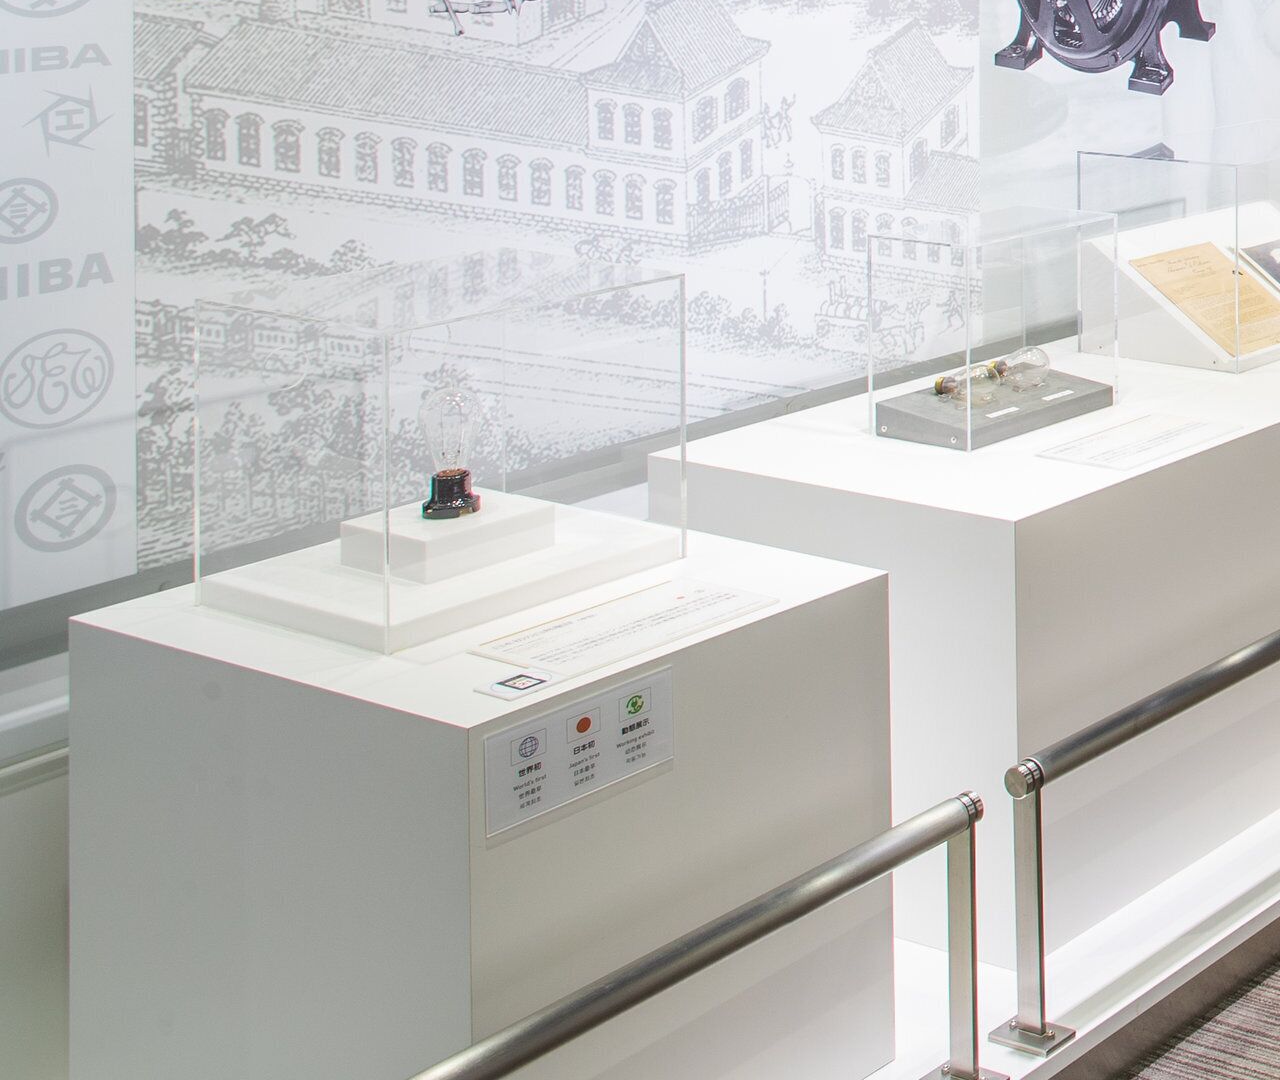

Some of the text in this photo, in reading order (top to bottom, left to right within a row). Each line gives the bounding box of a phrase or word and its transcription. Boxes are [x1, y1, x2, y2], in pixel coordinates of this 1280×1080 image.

[0, 252, 114, 301] IBA
[573, 740, 596, 755] 日本初
[518, 761, 542, 777] 世界初
[568, 752, 600, 769] Japan's first
[512, 774, 547, 792] World's first
